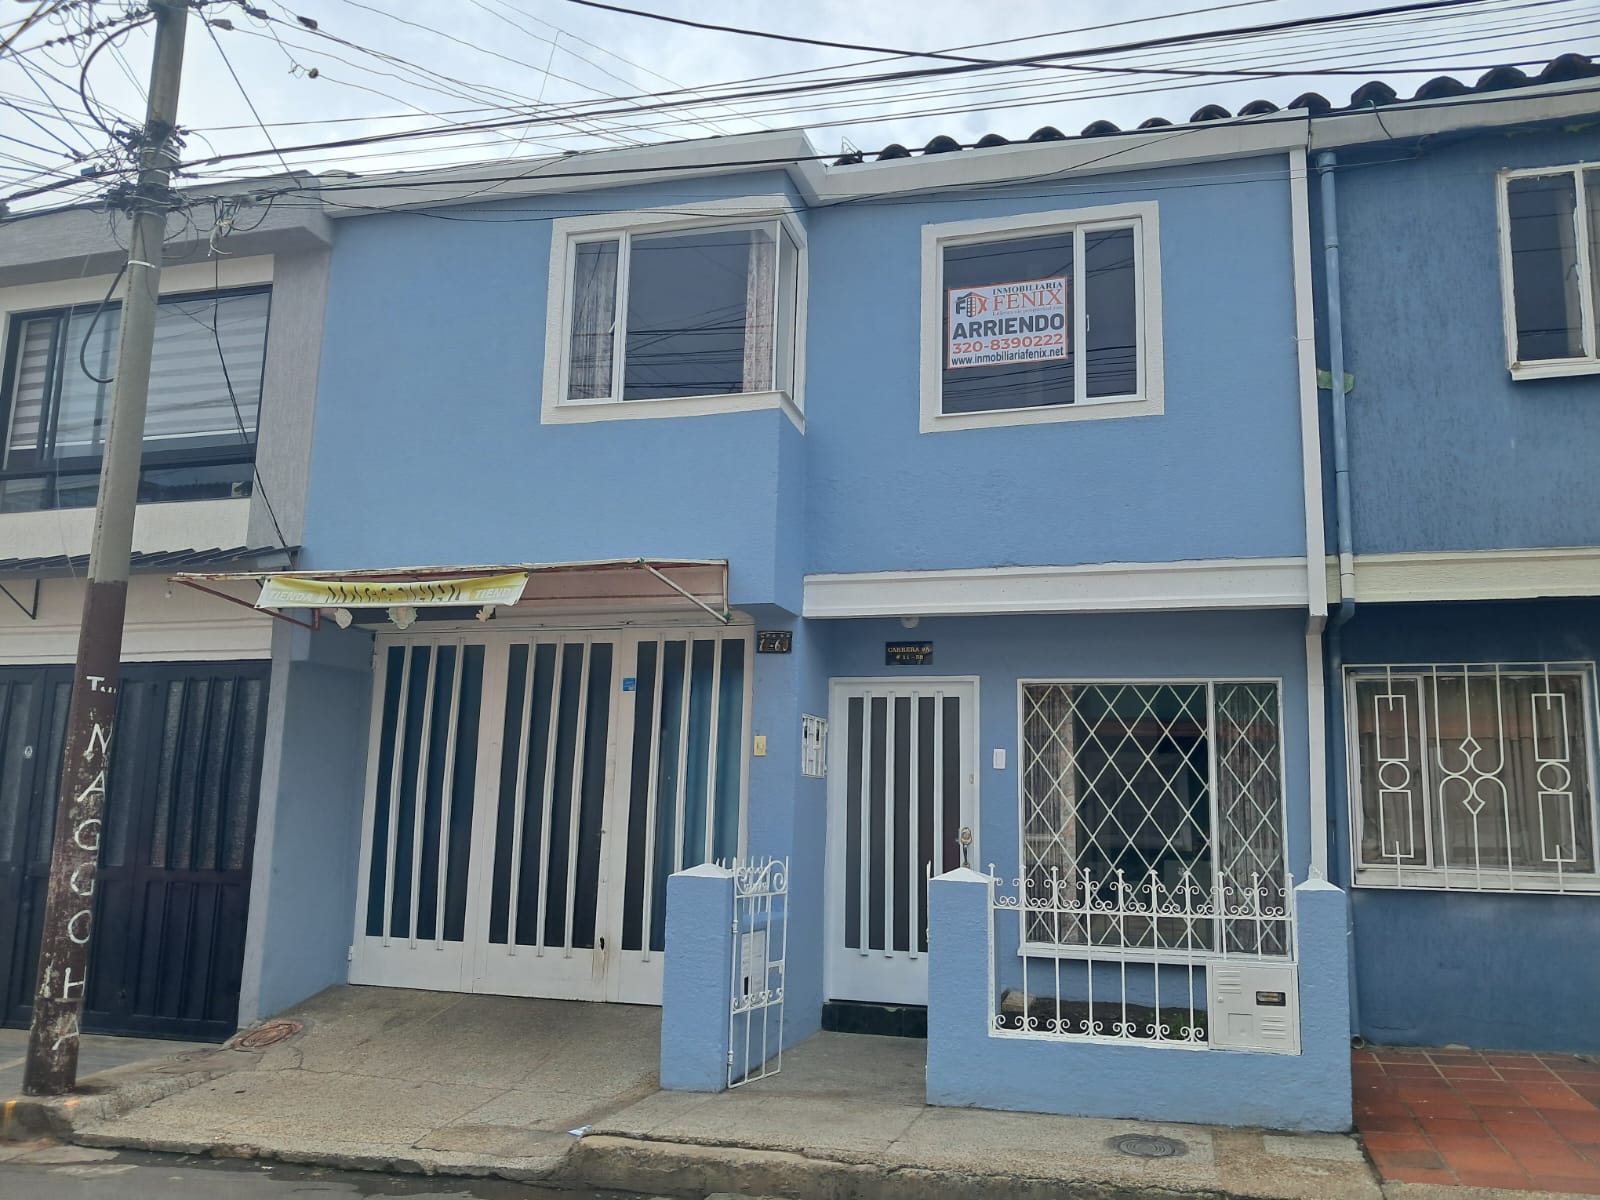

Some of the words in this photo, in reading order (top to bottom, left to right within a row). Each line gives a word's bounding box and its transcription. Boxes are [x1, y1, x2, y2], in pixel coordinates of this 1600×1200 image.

[993, 281, 1063, 295] INMOBILIARIA
[993, 289, 1064, 311] FENIX
[952, 313, 1065, 339] ARRIENDO
[953, 333, 1063, 354] 320-8390222
[951, 346, 1064, 366] www.inmobiliariafenix.net
